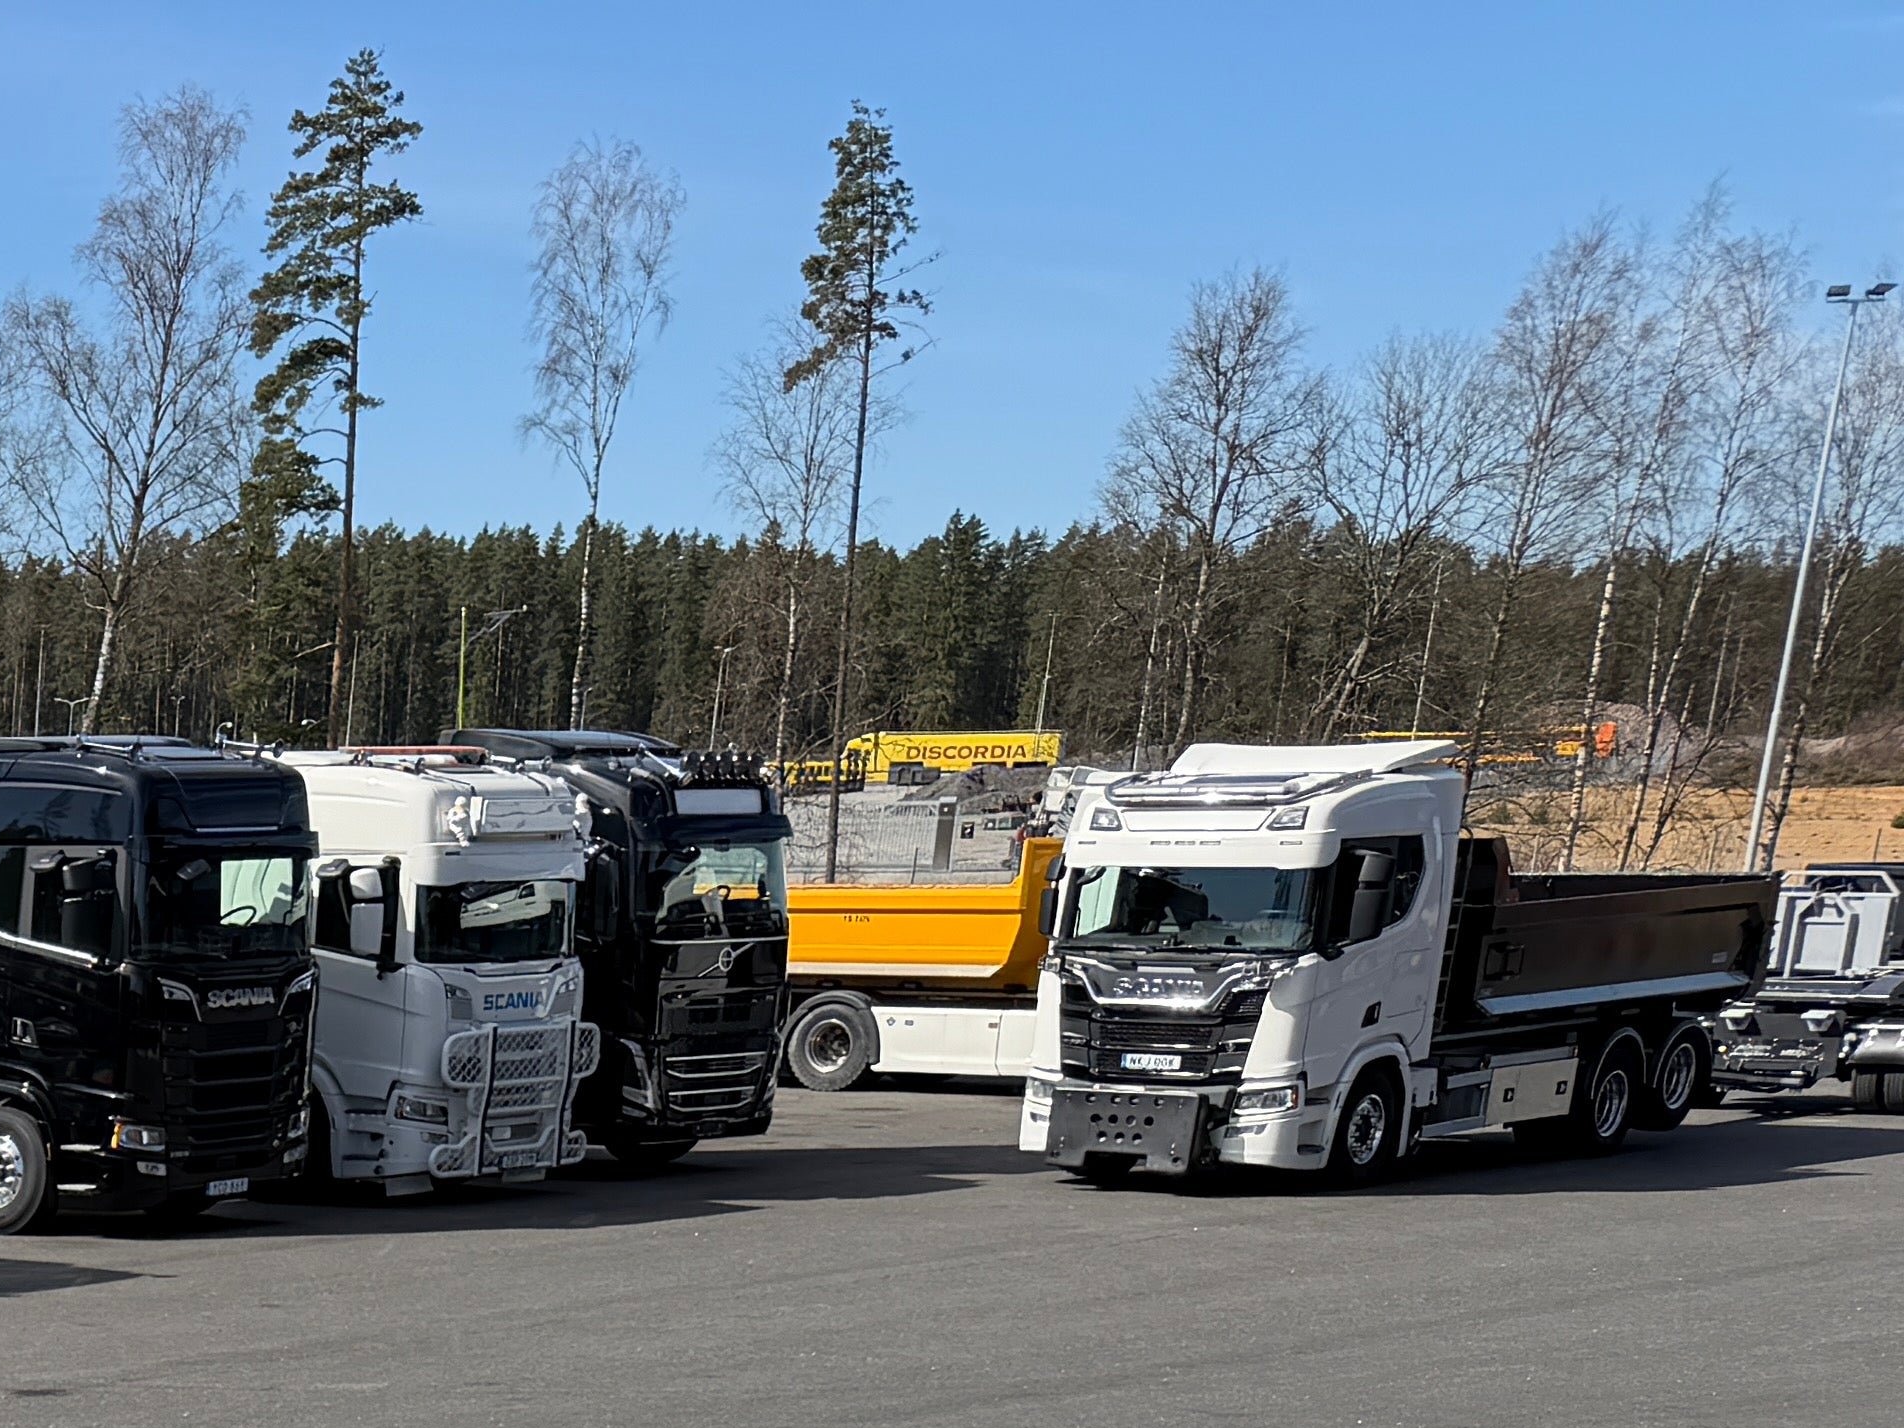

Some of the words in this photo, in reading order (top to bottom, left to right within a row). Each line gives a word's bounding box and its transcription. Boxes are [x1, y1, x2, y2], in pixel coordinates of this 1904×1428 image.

[906, 745, 1027, 760] DISCORDIA
[207, 986, 276, 1009] SCANIA
[483, 991, 546, 1011] SCANIA
